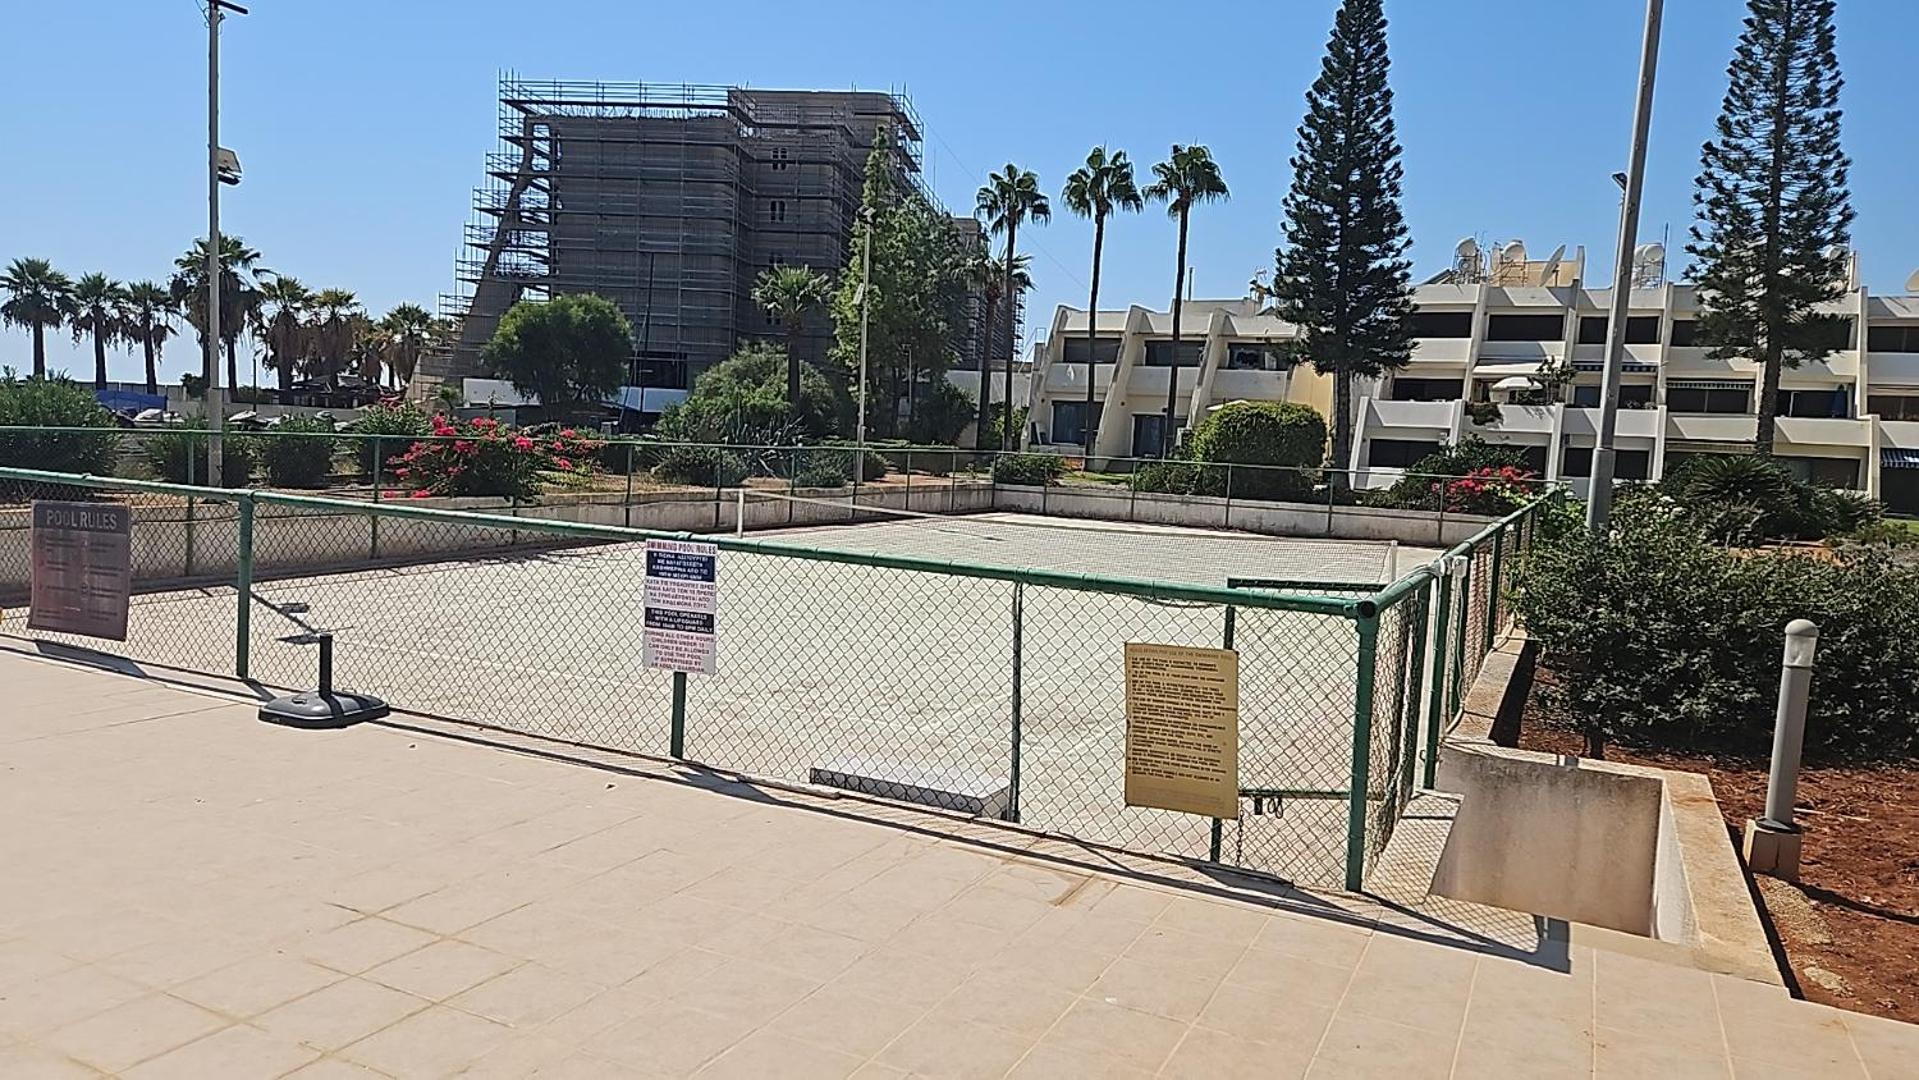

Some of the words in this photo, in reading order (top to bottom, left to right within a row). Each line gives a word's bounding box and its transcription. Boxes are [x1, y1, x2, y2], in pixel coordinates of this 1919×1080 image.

[46, 509, 78, 527] POOL
[80, 511, 117, 530] RULES
[647, 541, 677, 551] SWIMMING
[679, 543, 694, 553] POOL
[696, 544, 716, 555] RULES
